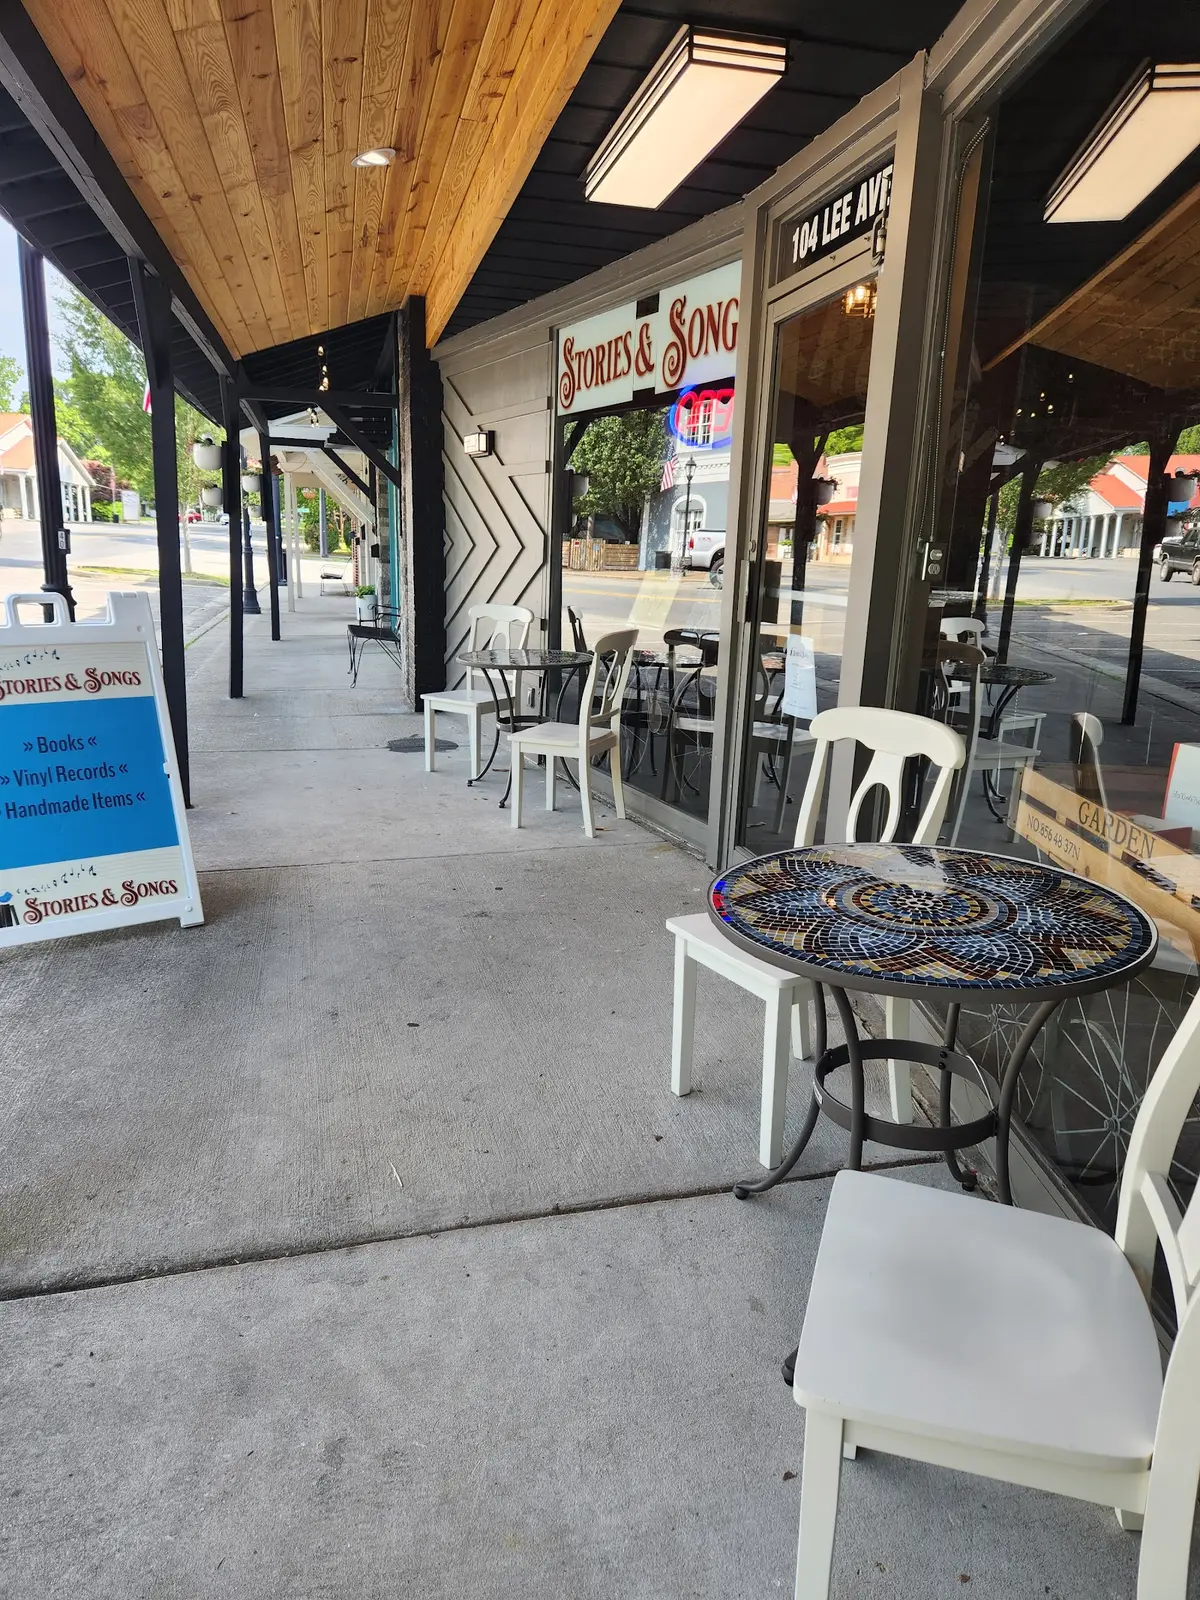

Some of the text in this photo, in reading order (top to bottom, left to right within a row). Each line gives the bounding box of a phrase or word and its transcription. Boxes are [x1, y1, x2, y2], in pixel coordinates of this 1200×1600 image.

[792, 215, 819, 264] 104
[822, 191, 853, 246] LEE
[559, 295, 739, 409] STORIES & SONG
[64, 673, 82, 691] &
[83, 667, 142, 693] SONGS
[36, 734, 84, 753] Books
[13, 762, 116, 787] Vinyl Records
[5, 792, 134, 819] Handmade Items
[1077, 801, 1157, 859] GARDEN
[23, 879, 179, 924] STORIES & SONGS
